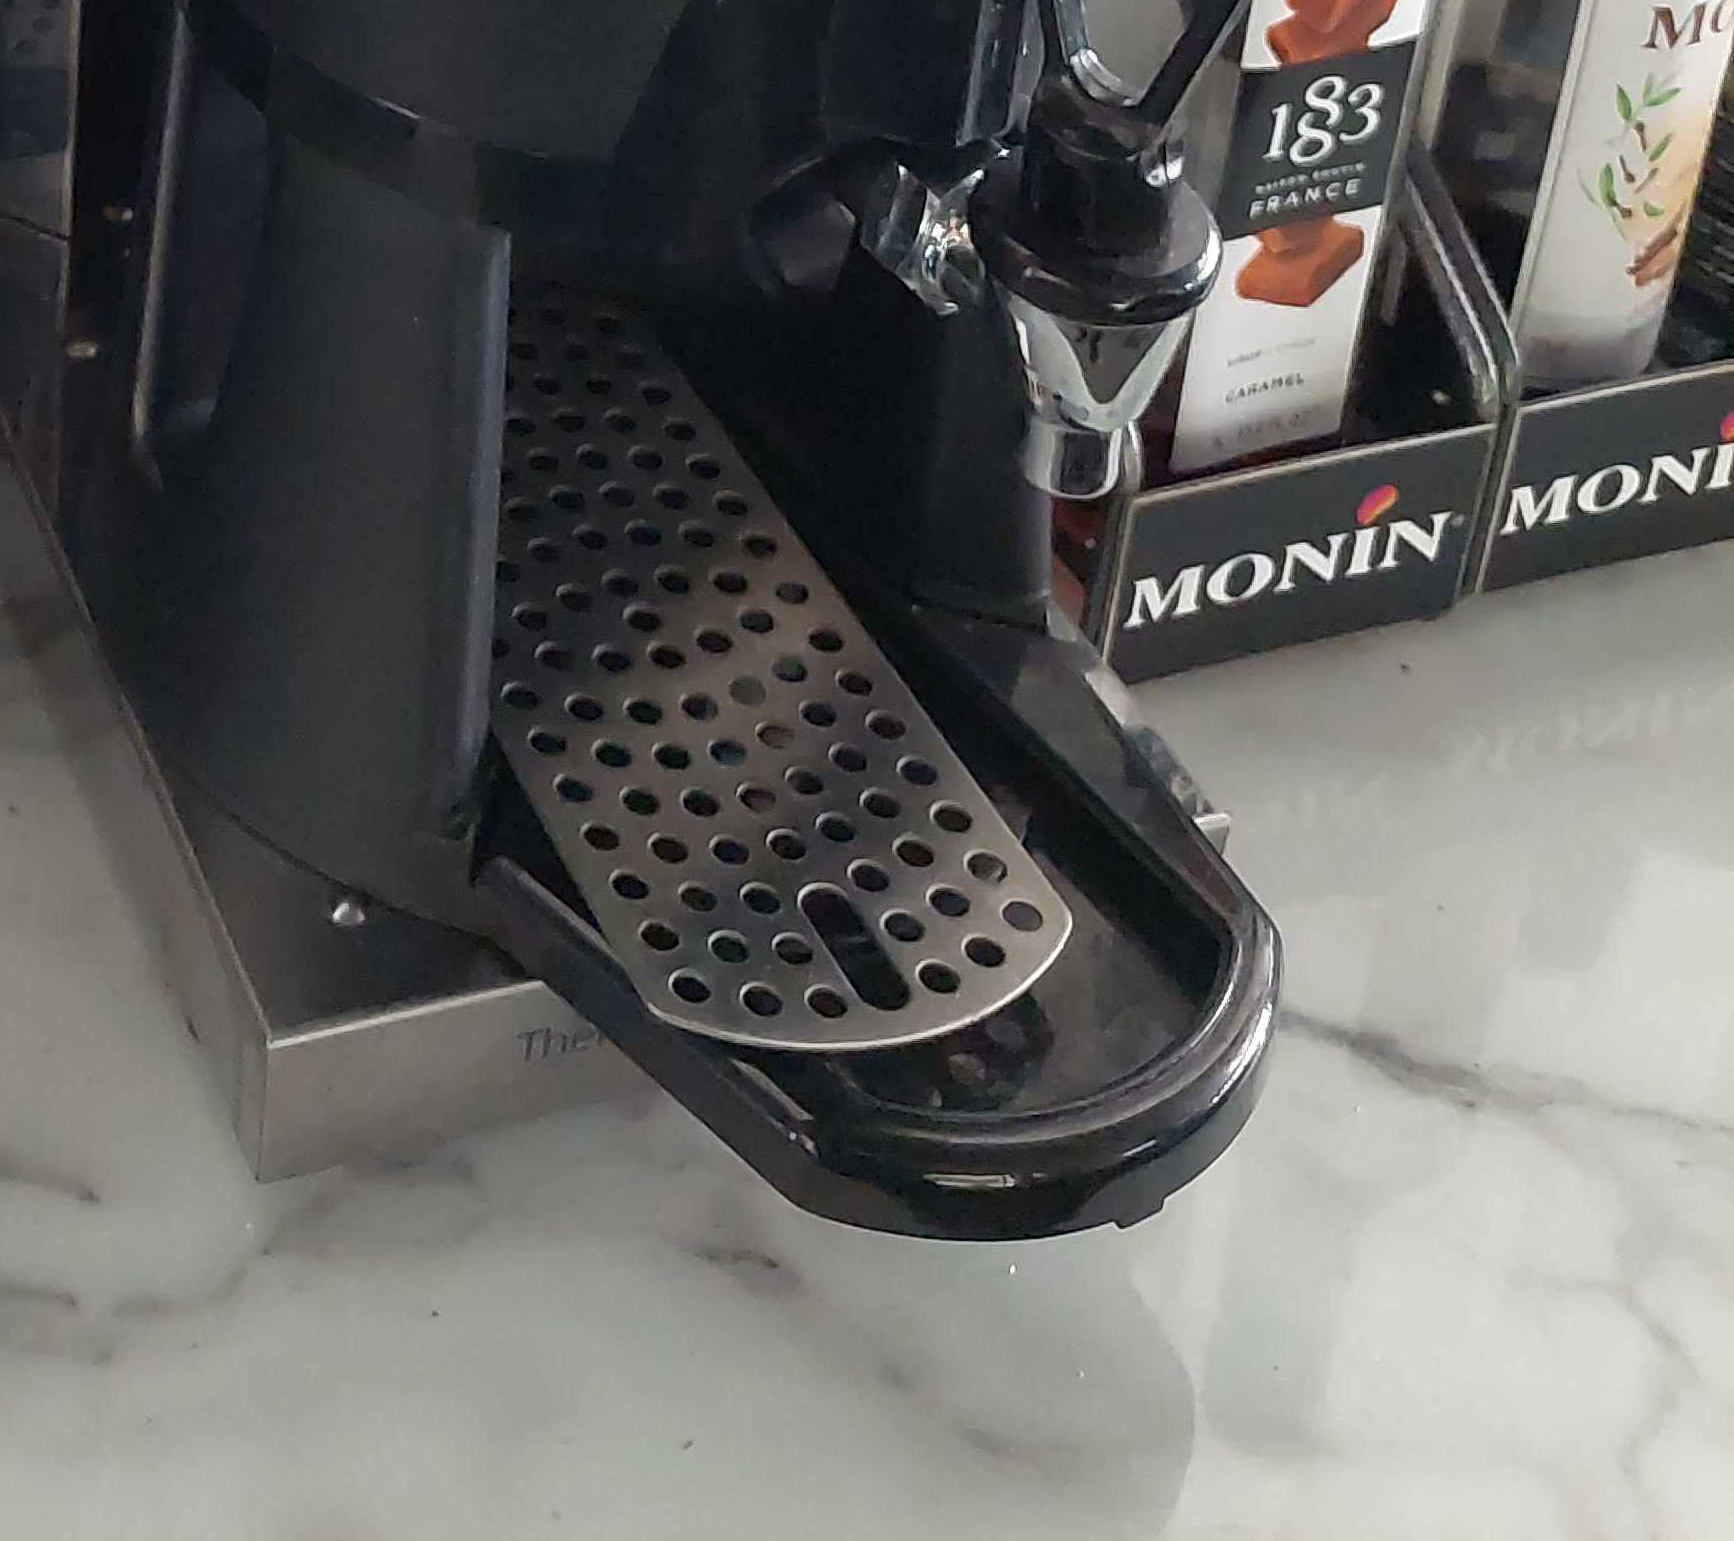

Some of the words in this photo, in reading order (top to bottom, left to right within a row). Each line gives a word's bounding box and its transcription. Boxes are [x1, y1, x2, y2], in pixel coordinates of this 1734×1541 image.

[1262, 74, 1385, 165] 1883
[1248, 177, 1364, 221] FRANCE
[1224, 372, 1306, 404] CARAMEL
[1122, 509, 1454, 630] MONIN
